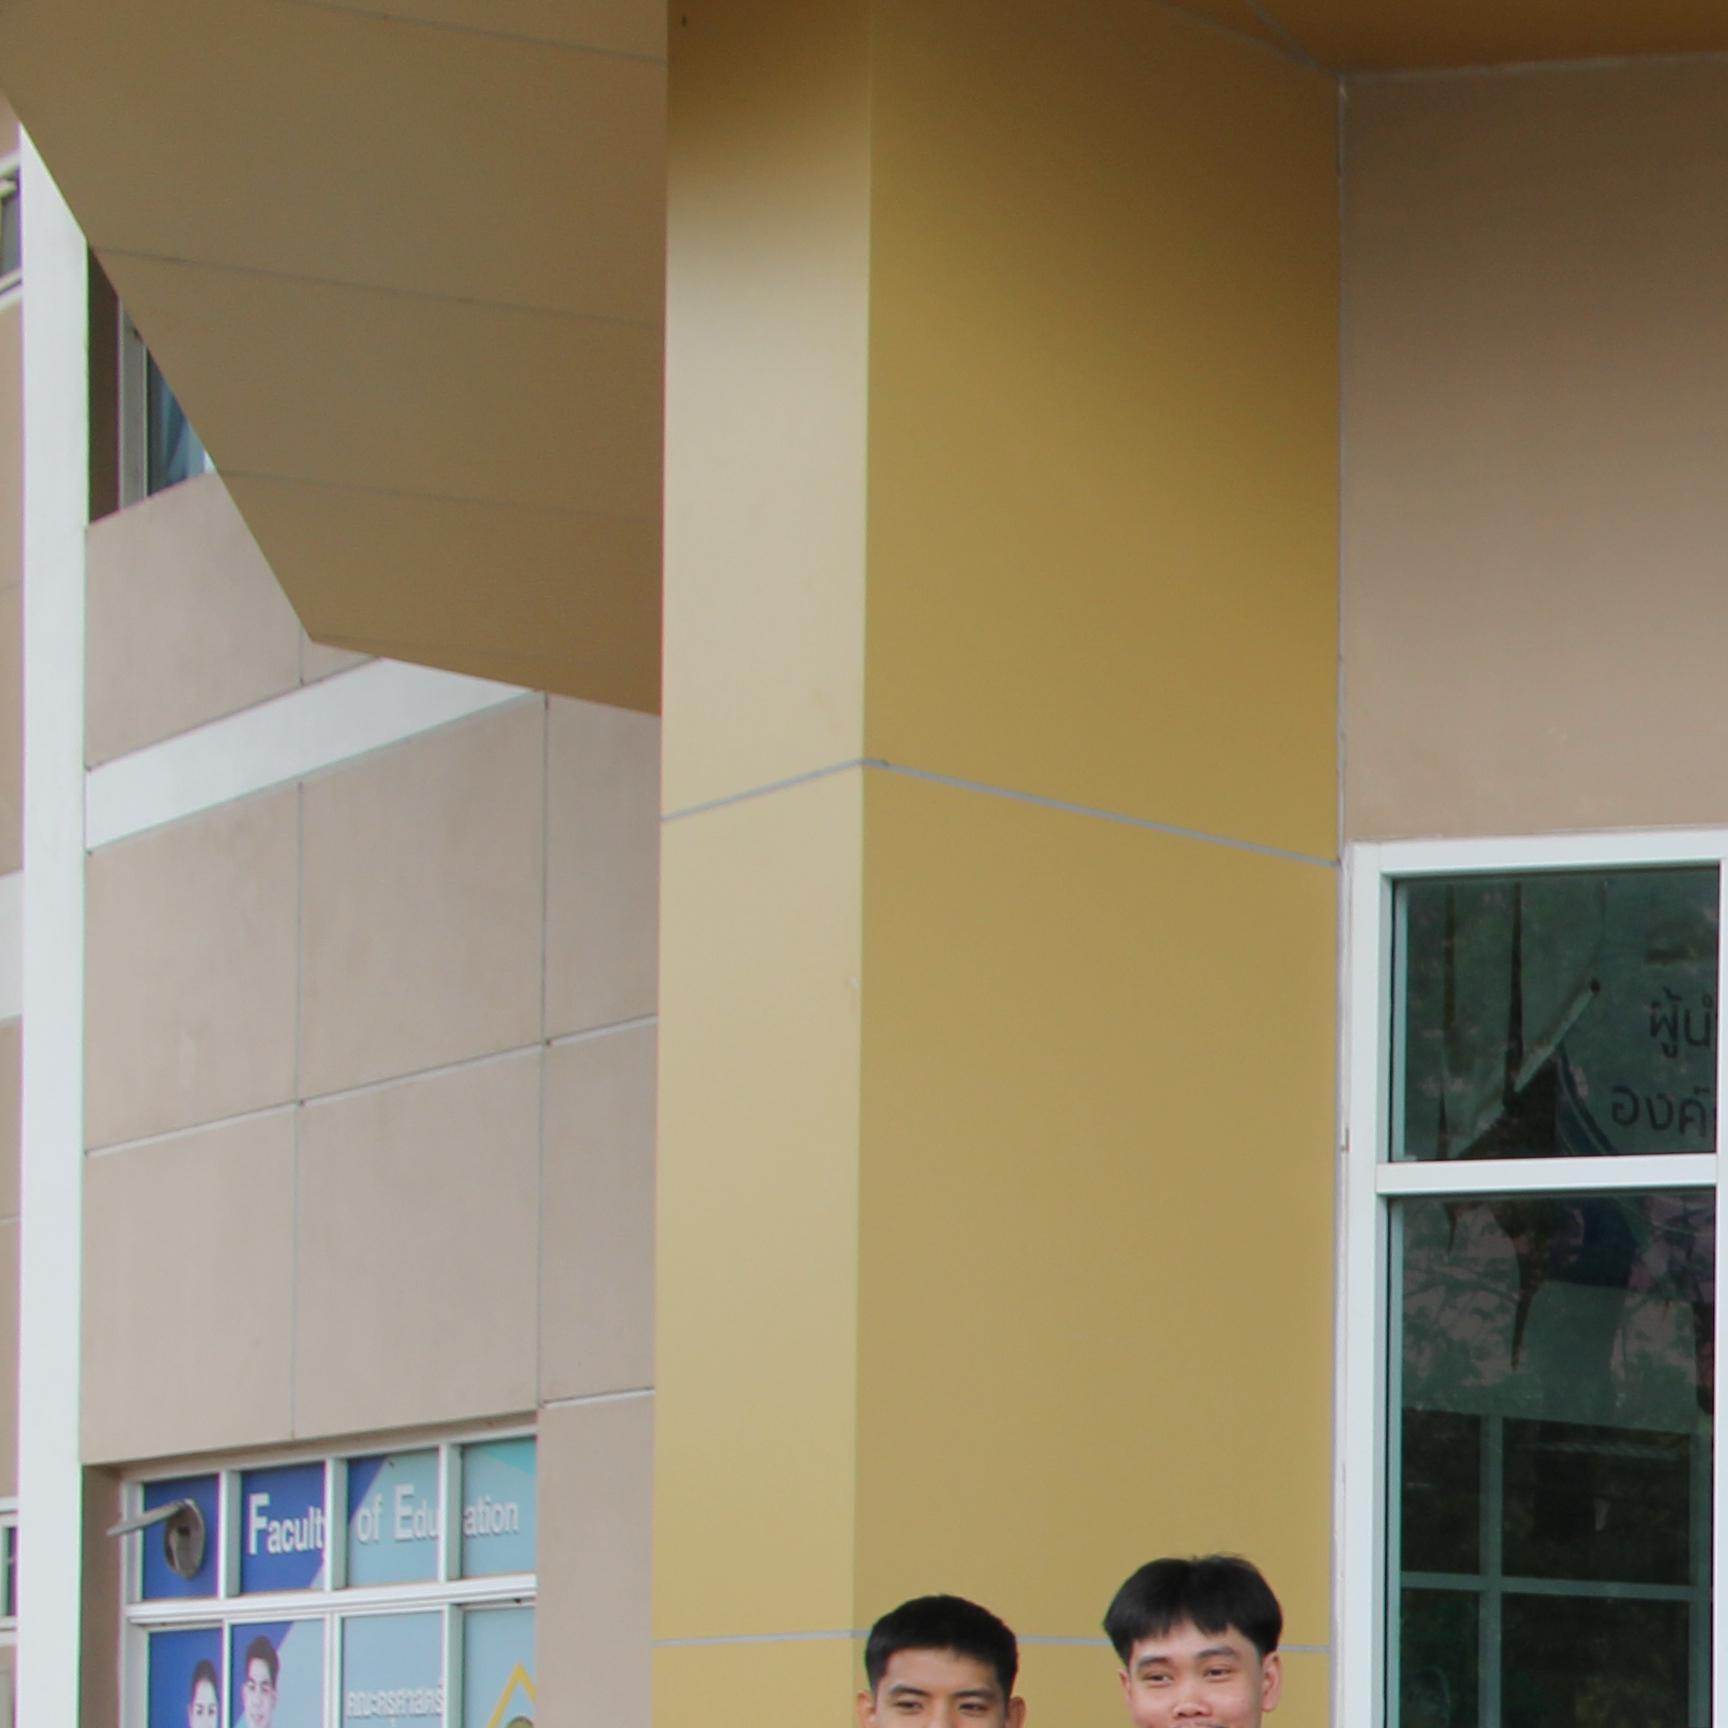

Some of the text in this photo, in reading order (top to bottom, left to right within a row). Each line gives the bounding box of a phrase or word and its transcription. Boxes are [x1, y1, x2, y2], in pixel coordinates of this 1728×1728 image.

[249, 1483, 519, 1556] Facult of Eduation
